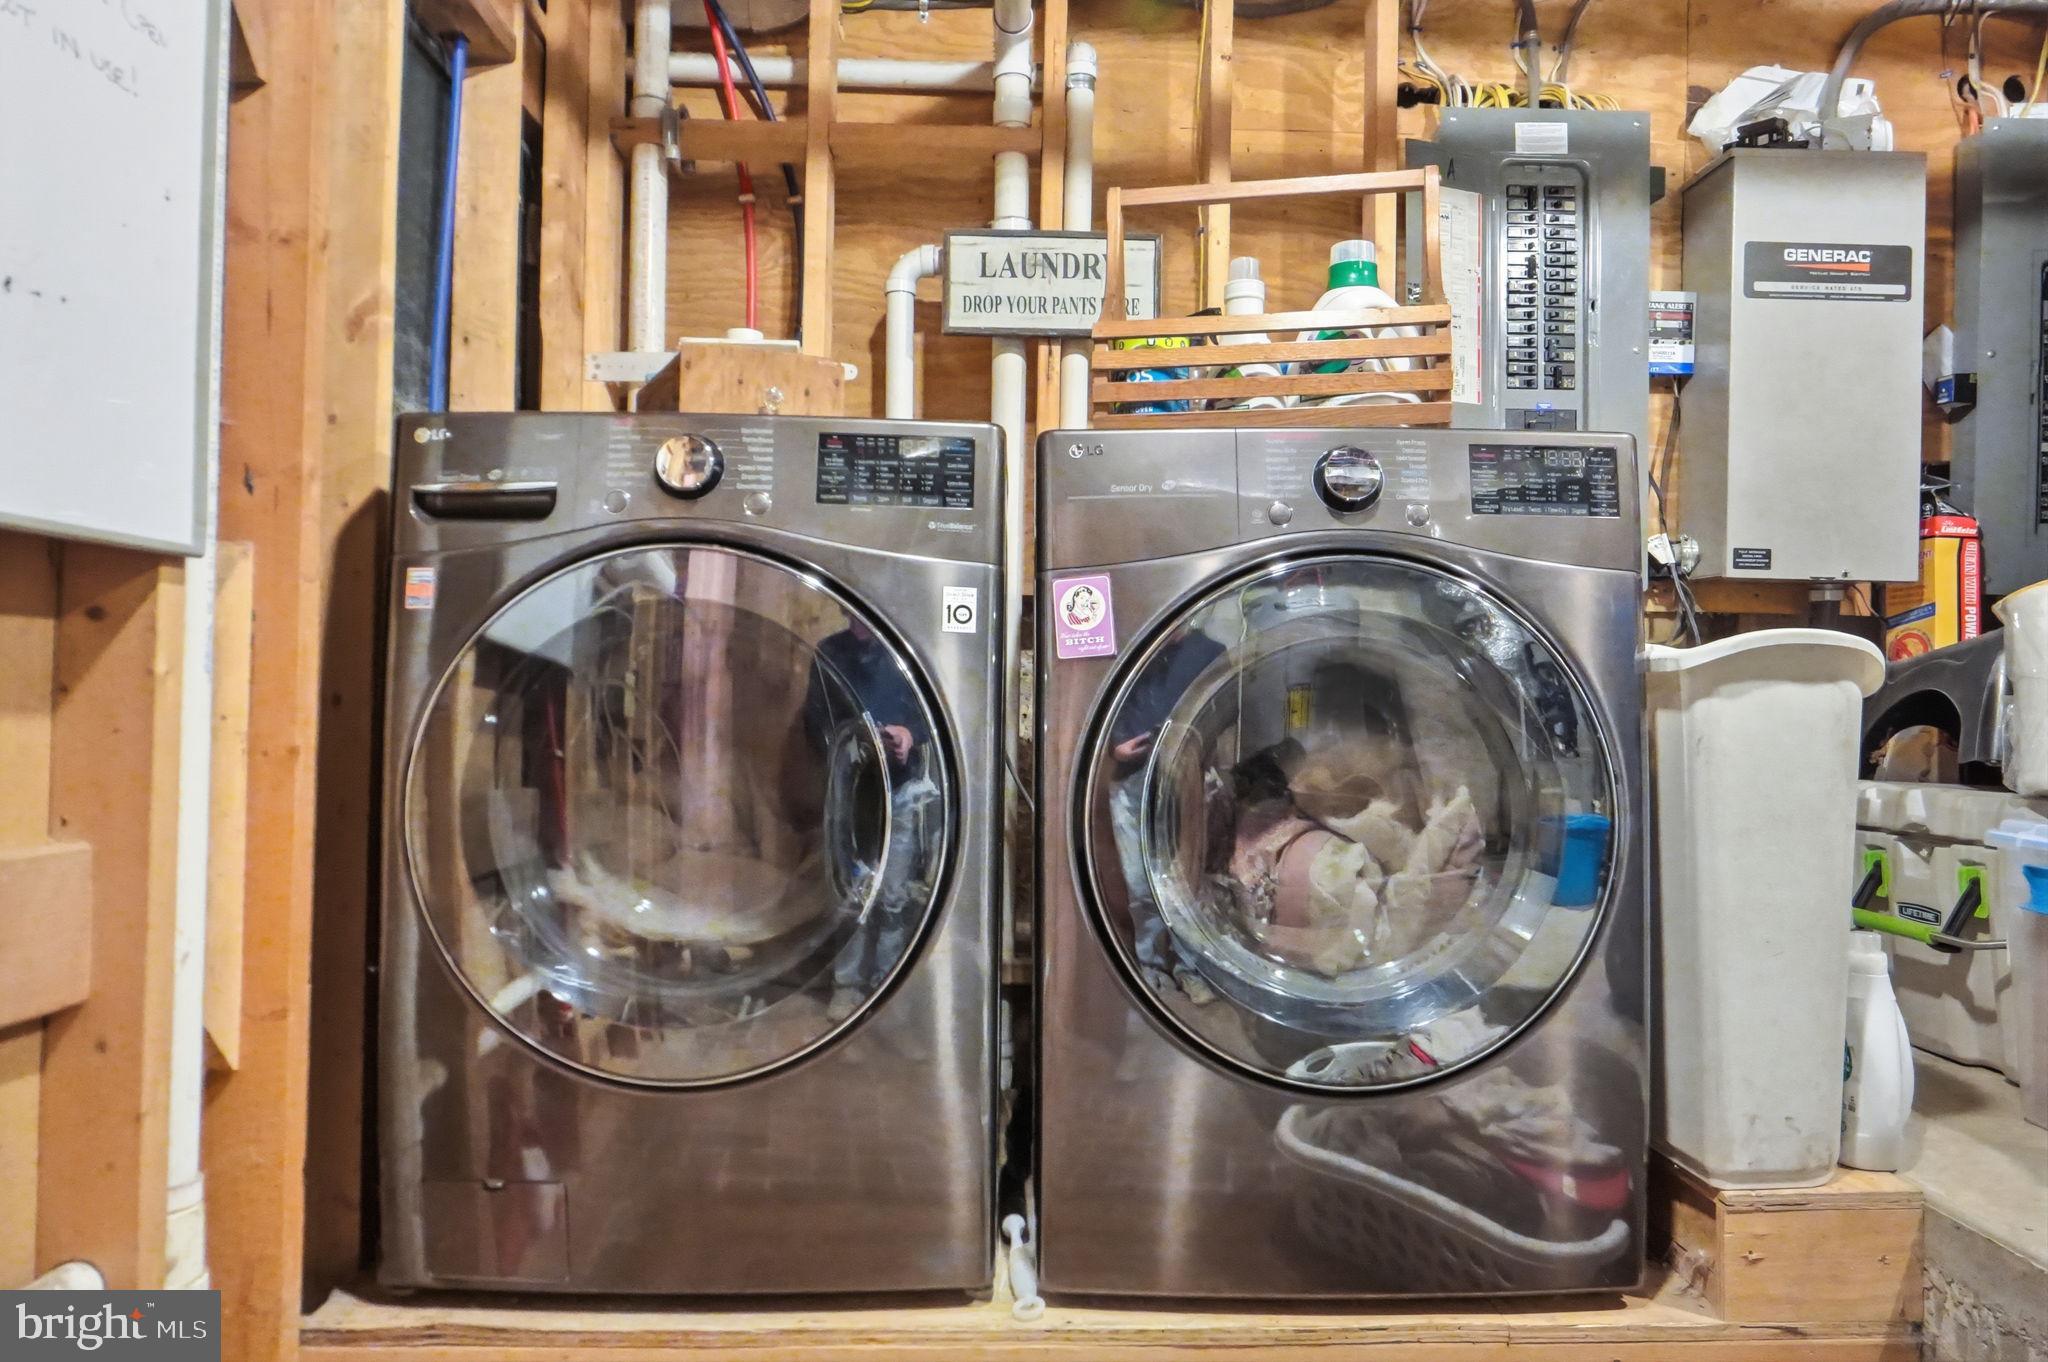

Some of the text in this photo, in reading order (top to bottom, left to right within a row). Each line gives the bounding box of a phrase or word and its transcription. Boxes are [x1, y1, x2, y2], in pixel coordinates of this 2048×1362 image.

[1446, 157, 1456, 181] A
[1783, 248, 1872, 263] GENERAC
[963, 295, 1001, 314] DROP
[1007, 295, 1048, 315] YOUR
[1052, 297, 1096, 316] PANTS
[1087, 444, 1104, 456] LG
[1111, 484, 1137, 492] Sensor
[1138, 483, 1152, 493] Dry
[946, 603, 973, 624] 10
[1964, 606, 1977, 640] POWE
[1064, 636, 1105, 646] BITCH
